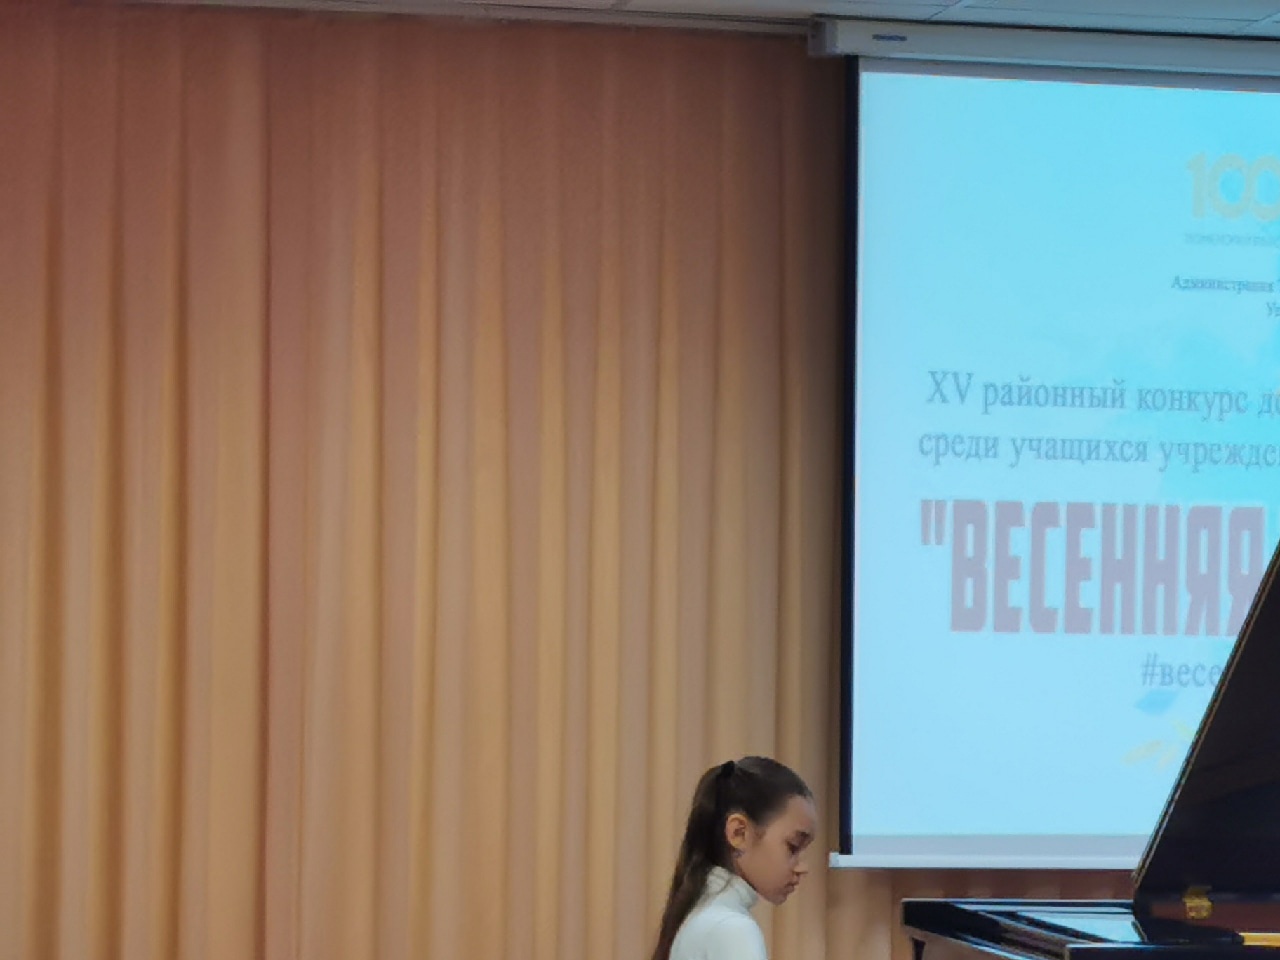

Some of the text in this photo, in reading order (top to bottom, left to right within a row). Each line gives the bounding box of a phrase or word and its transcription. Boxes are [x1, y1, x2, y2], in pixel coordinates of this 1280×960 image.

[927, 371, 974, 404] XV
[981, 375, 1126, 415] районный
[1137, 385, 1249, 422] конкурс
[919, 432, 999, 465] среди
[1010, 433, 1149, 467] учащихся
